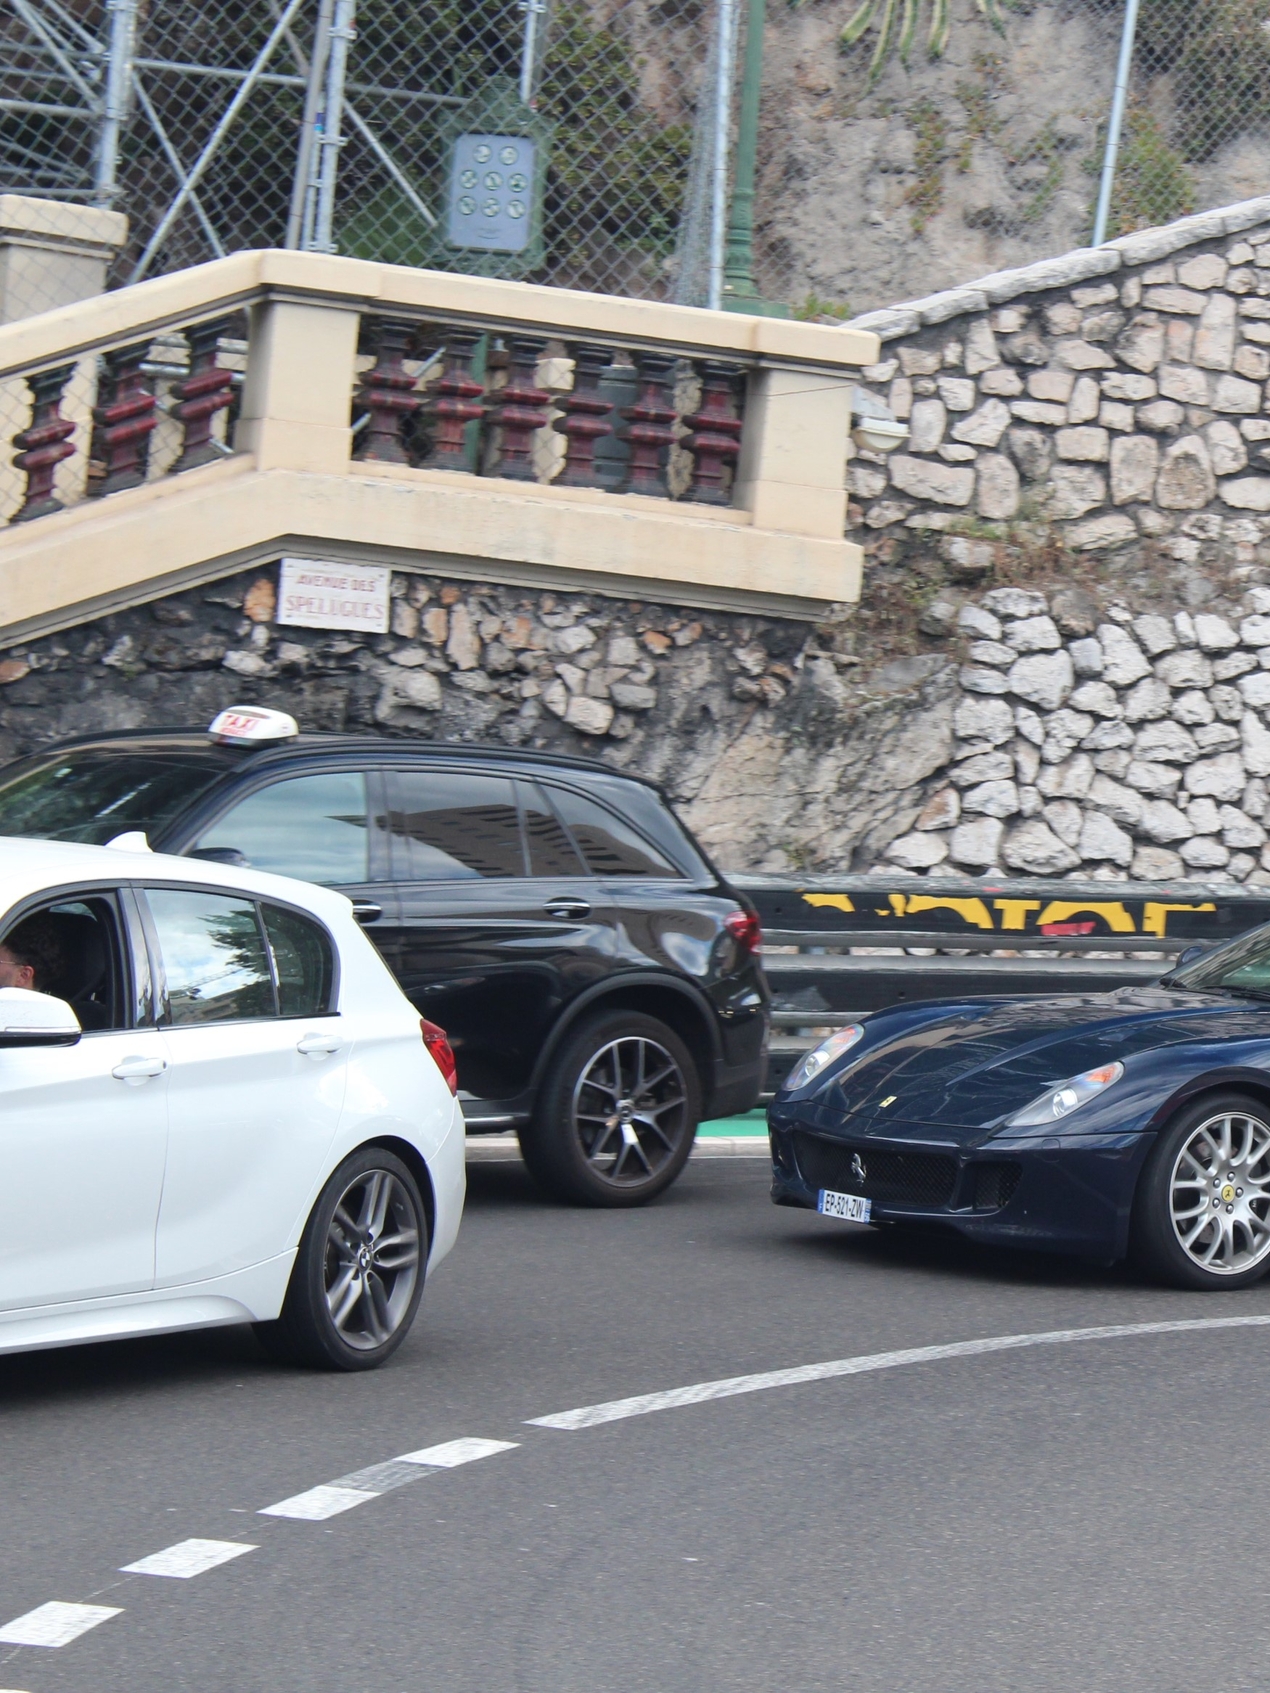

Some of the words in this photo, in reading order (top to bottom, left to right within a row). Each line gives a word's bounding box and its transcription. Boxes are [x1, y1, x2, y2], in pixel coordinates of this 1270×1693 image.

[296, 575, 348, 590] AVENUE
[351, 580, 376, 592] DES
[825, 1193, 863, 1218] EP-521-ZW
